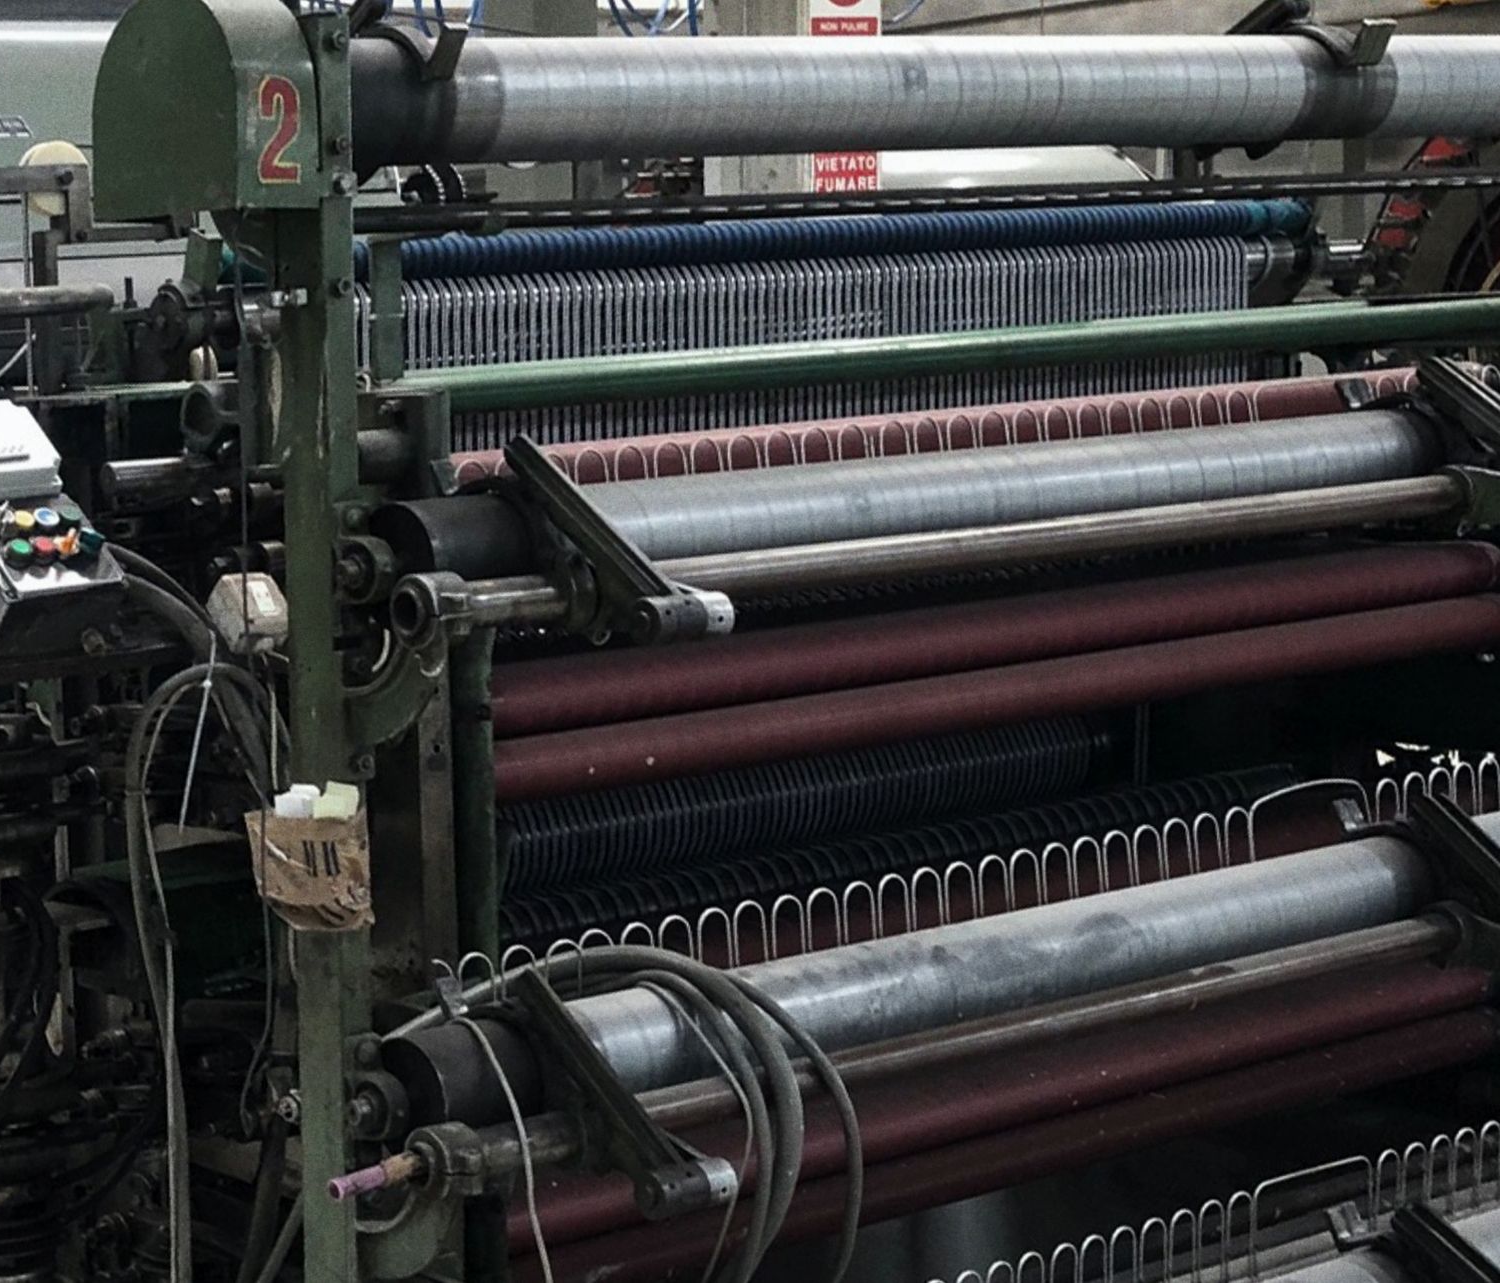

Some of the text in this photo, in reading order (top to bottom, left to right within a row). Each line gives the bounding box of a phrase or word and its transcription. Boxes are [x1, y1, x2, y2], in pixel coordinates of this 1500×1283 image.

[820, 21, 839, 31] NON
[257, 74, 301, 184] 2
[816, 156, 876, 171] VIETATO
[815, 175, 876, 193] FUMARE
